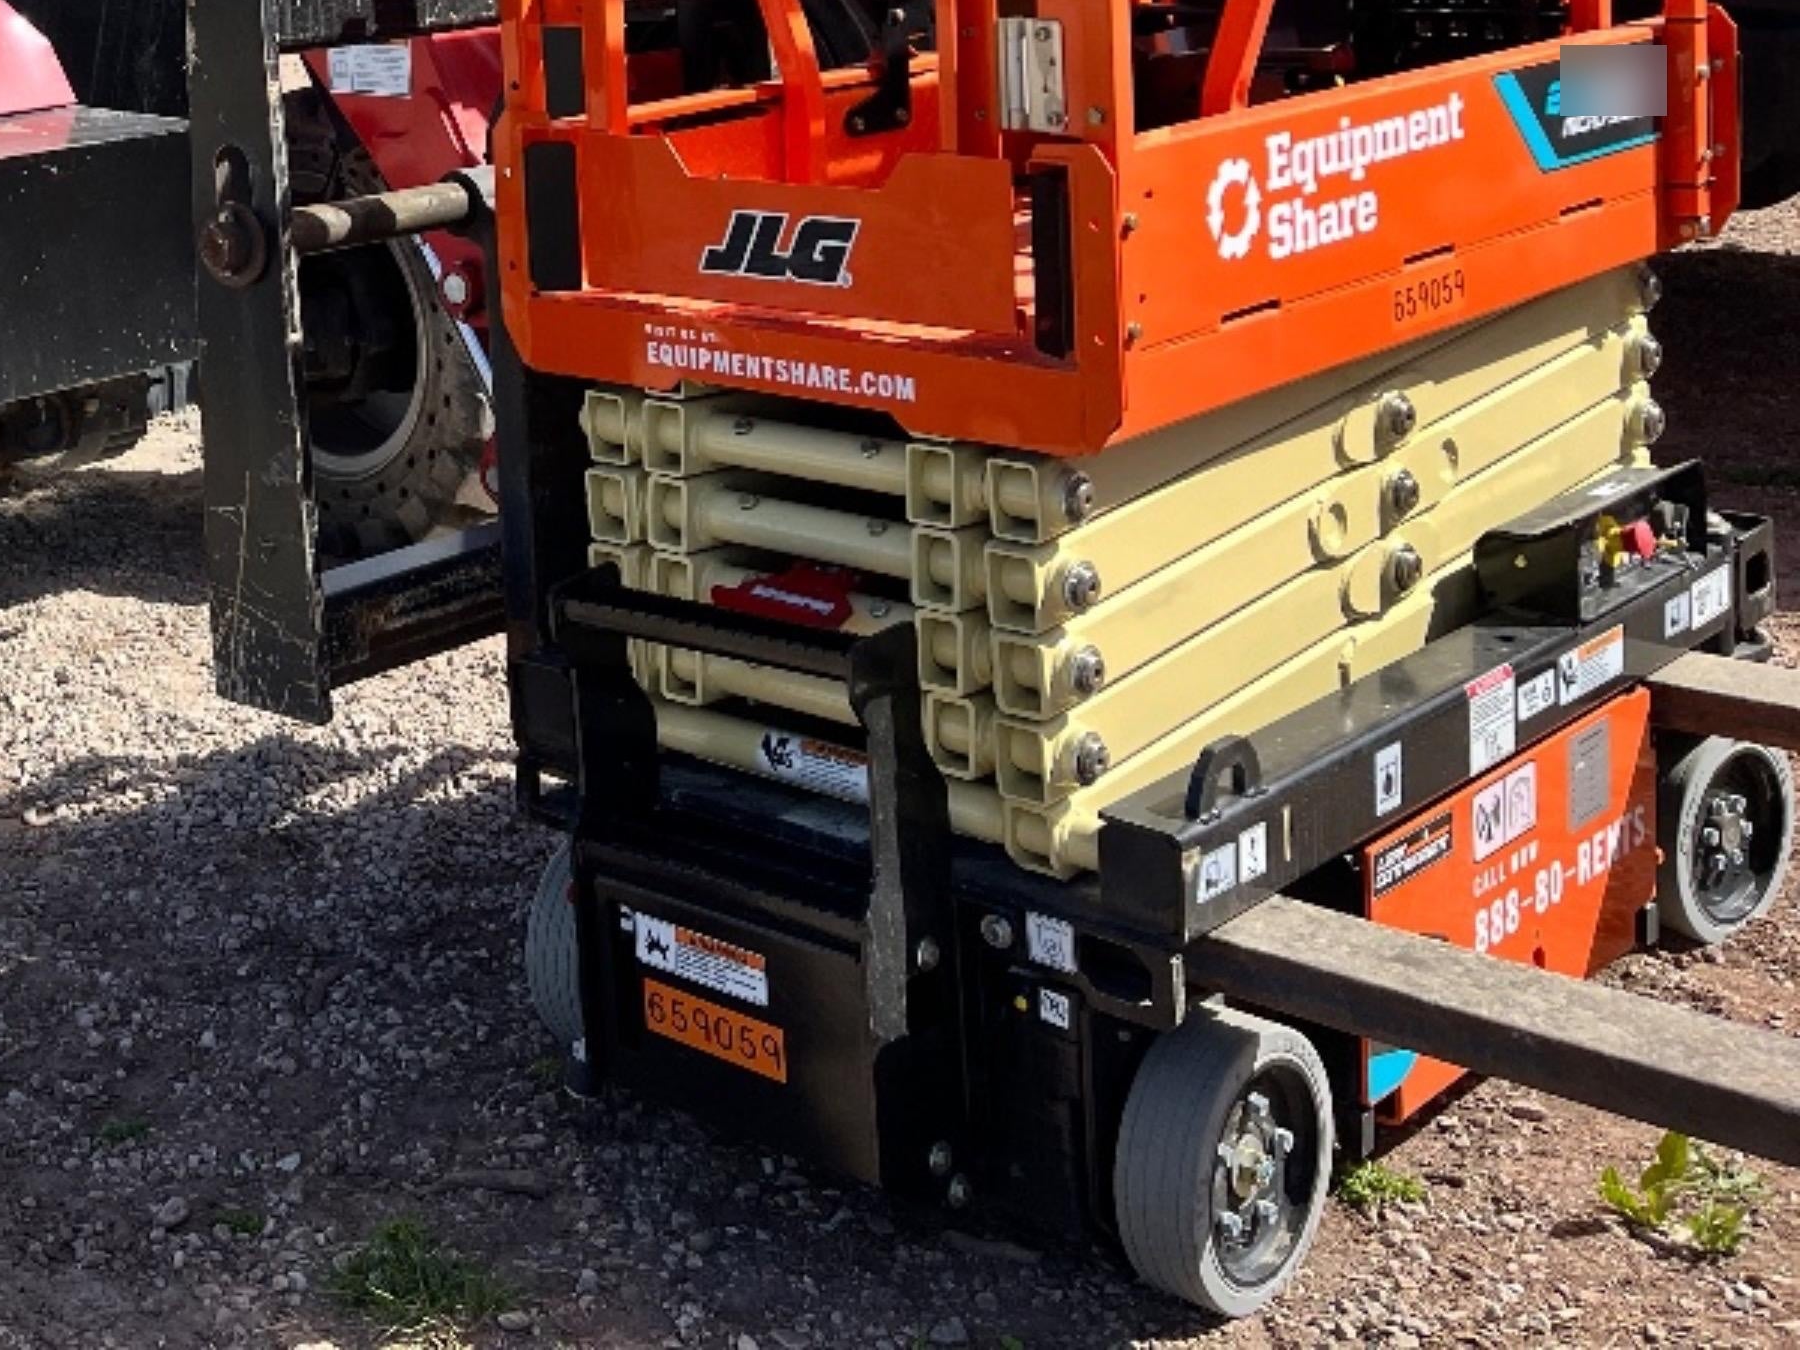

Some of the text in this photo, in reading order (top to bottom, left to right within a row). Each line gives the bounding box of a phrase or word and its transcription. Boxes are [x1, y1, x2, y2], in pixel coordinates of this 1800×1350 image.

[1265, 92, 1465, 194] Equipment
[699, 209, 861, 286] JLG
[1267, 191, 1378, 259] Share
[1394, 269, 1465, 322] 659059
[646, 341, 917, 402] EQUIPMENTSHARE.COM
[649, 992, 782, 1071] 659059
